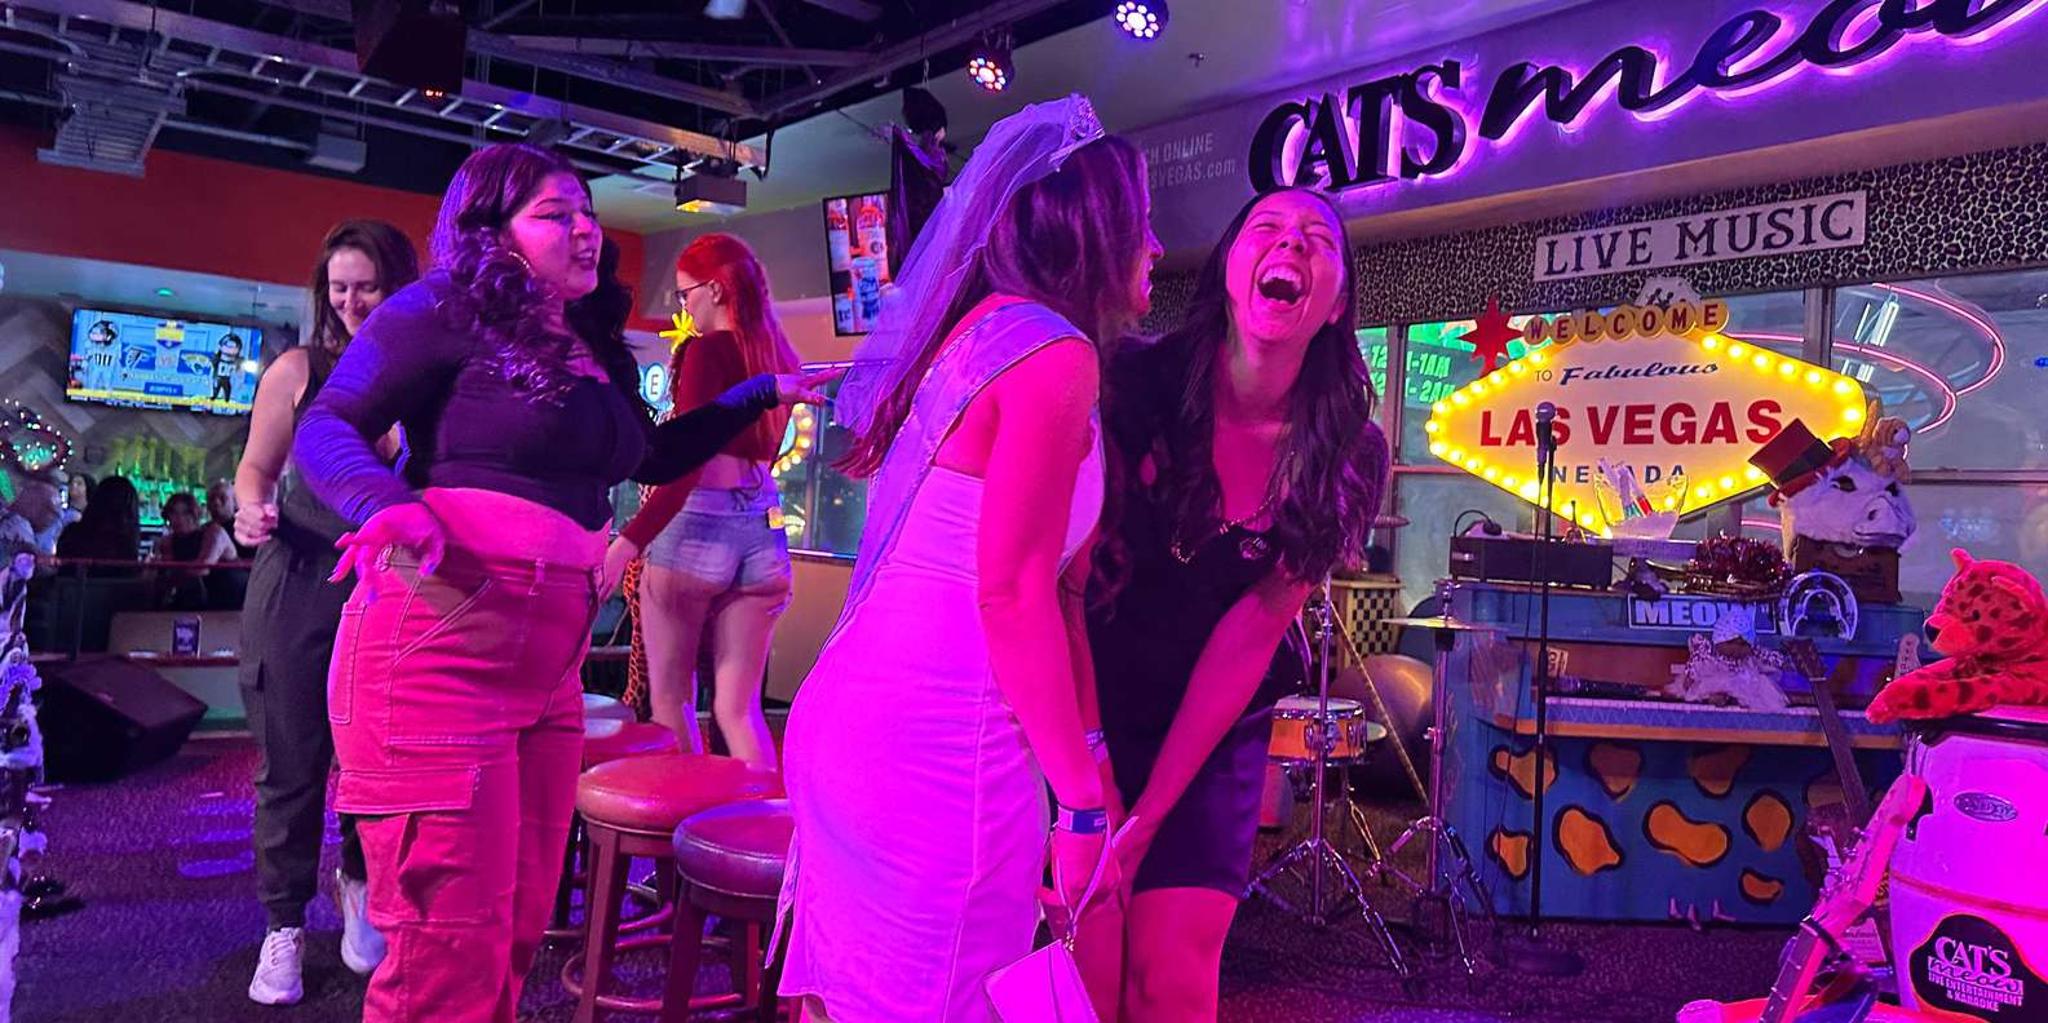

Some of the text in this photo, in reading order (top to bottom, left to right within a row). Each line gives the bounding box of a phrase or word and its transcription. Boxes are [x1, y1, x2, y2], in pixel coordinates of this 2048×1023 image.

[1163, 132, 1214, 163] ONLINE
[1543, 199, 1855, 276] LIVE MUSIC
[1528, 303, 1720, 341] WELCOME
[1535, 361, 1719, 385] TO Fabulous
[1480, 400, 1782, 447] LAS VEGAS
[1935, 936, 2012, 978] CAT'S
[1945, 978, 2024, 1007] ENTERTAINMENT
[1955, 991, 2000, 1012] KARAOKE
